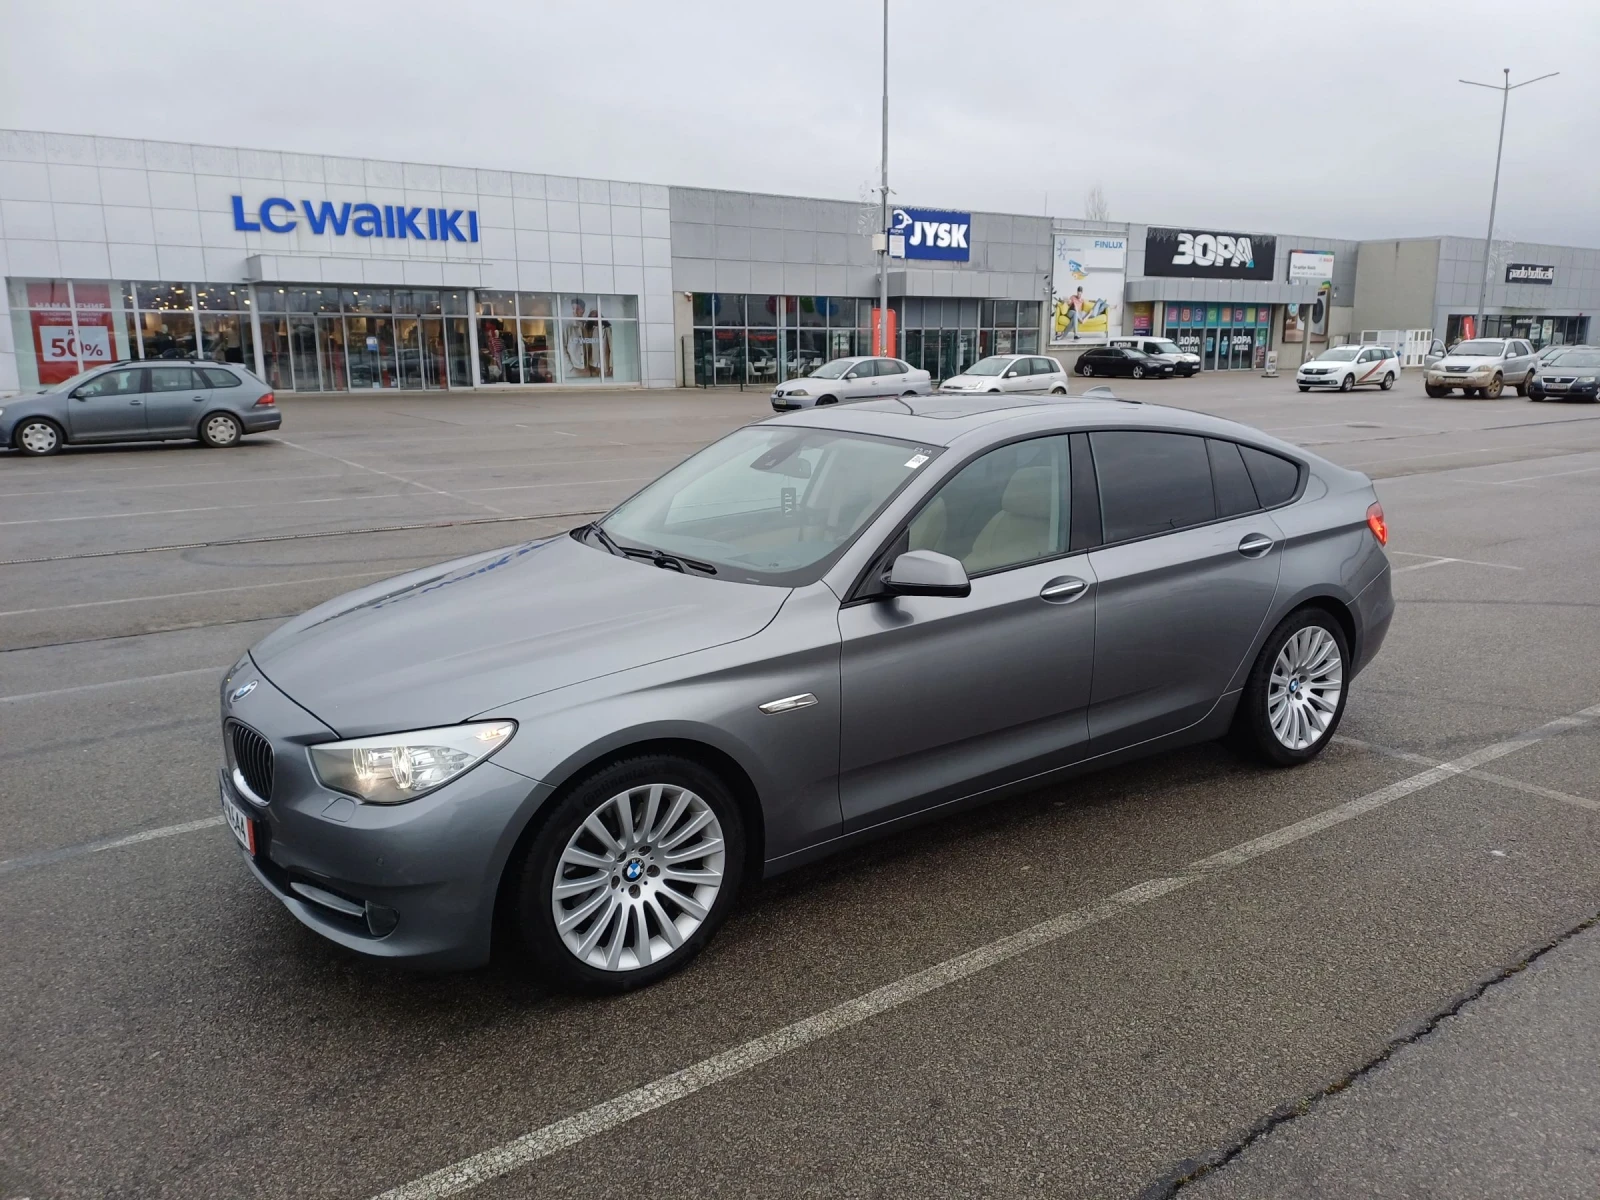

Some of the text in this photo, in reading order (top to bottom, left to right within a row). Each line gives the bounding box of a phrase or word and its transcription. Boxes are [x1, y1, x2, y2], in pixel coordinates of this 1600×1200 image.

[231, 195, 297, 233] LC
[909, 221, 968, 249] JYSK
[1094, 240, 1123, 249] FINLUX
[1172, 233, 1255, 268] ЗОРА
[51, 338, 103, 358] 50%
